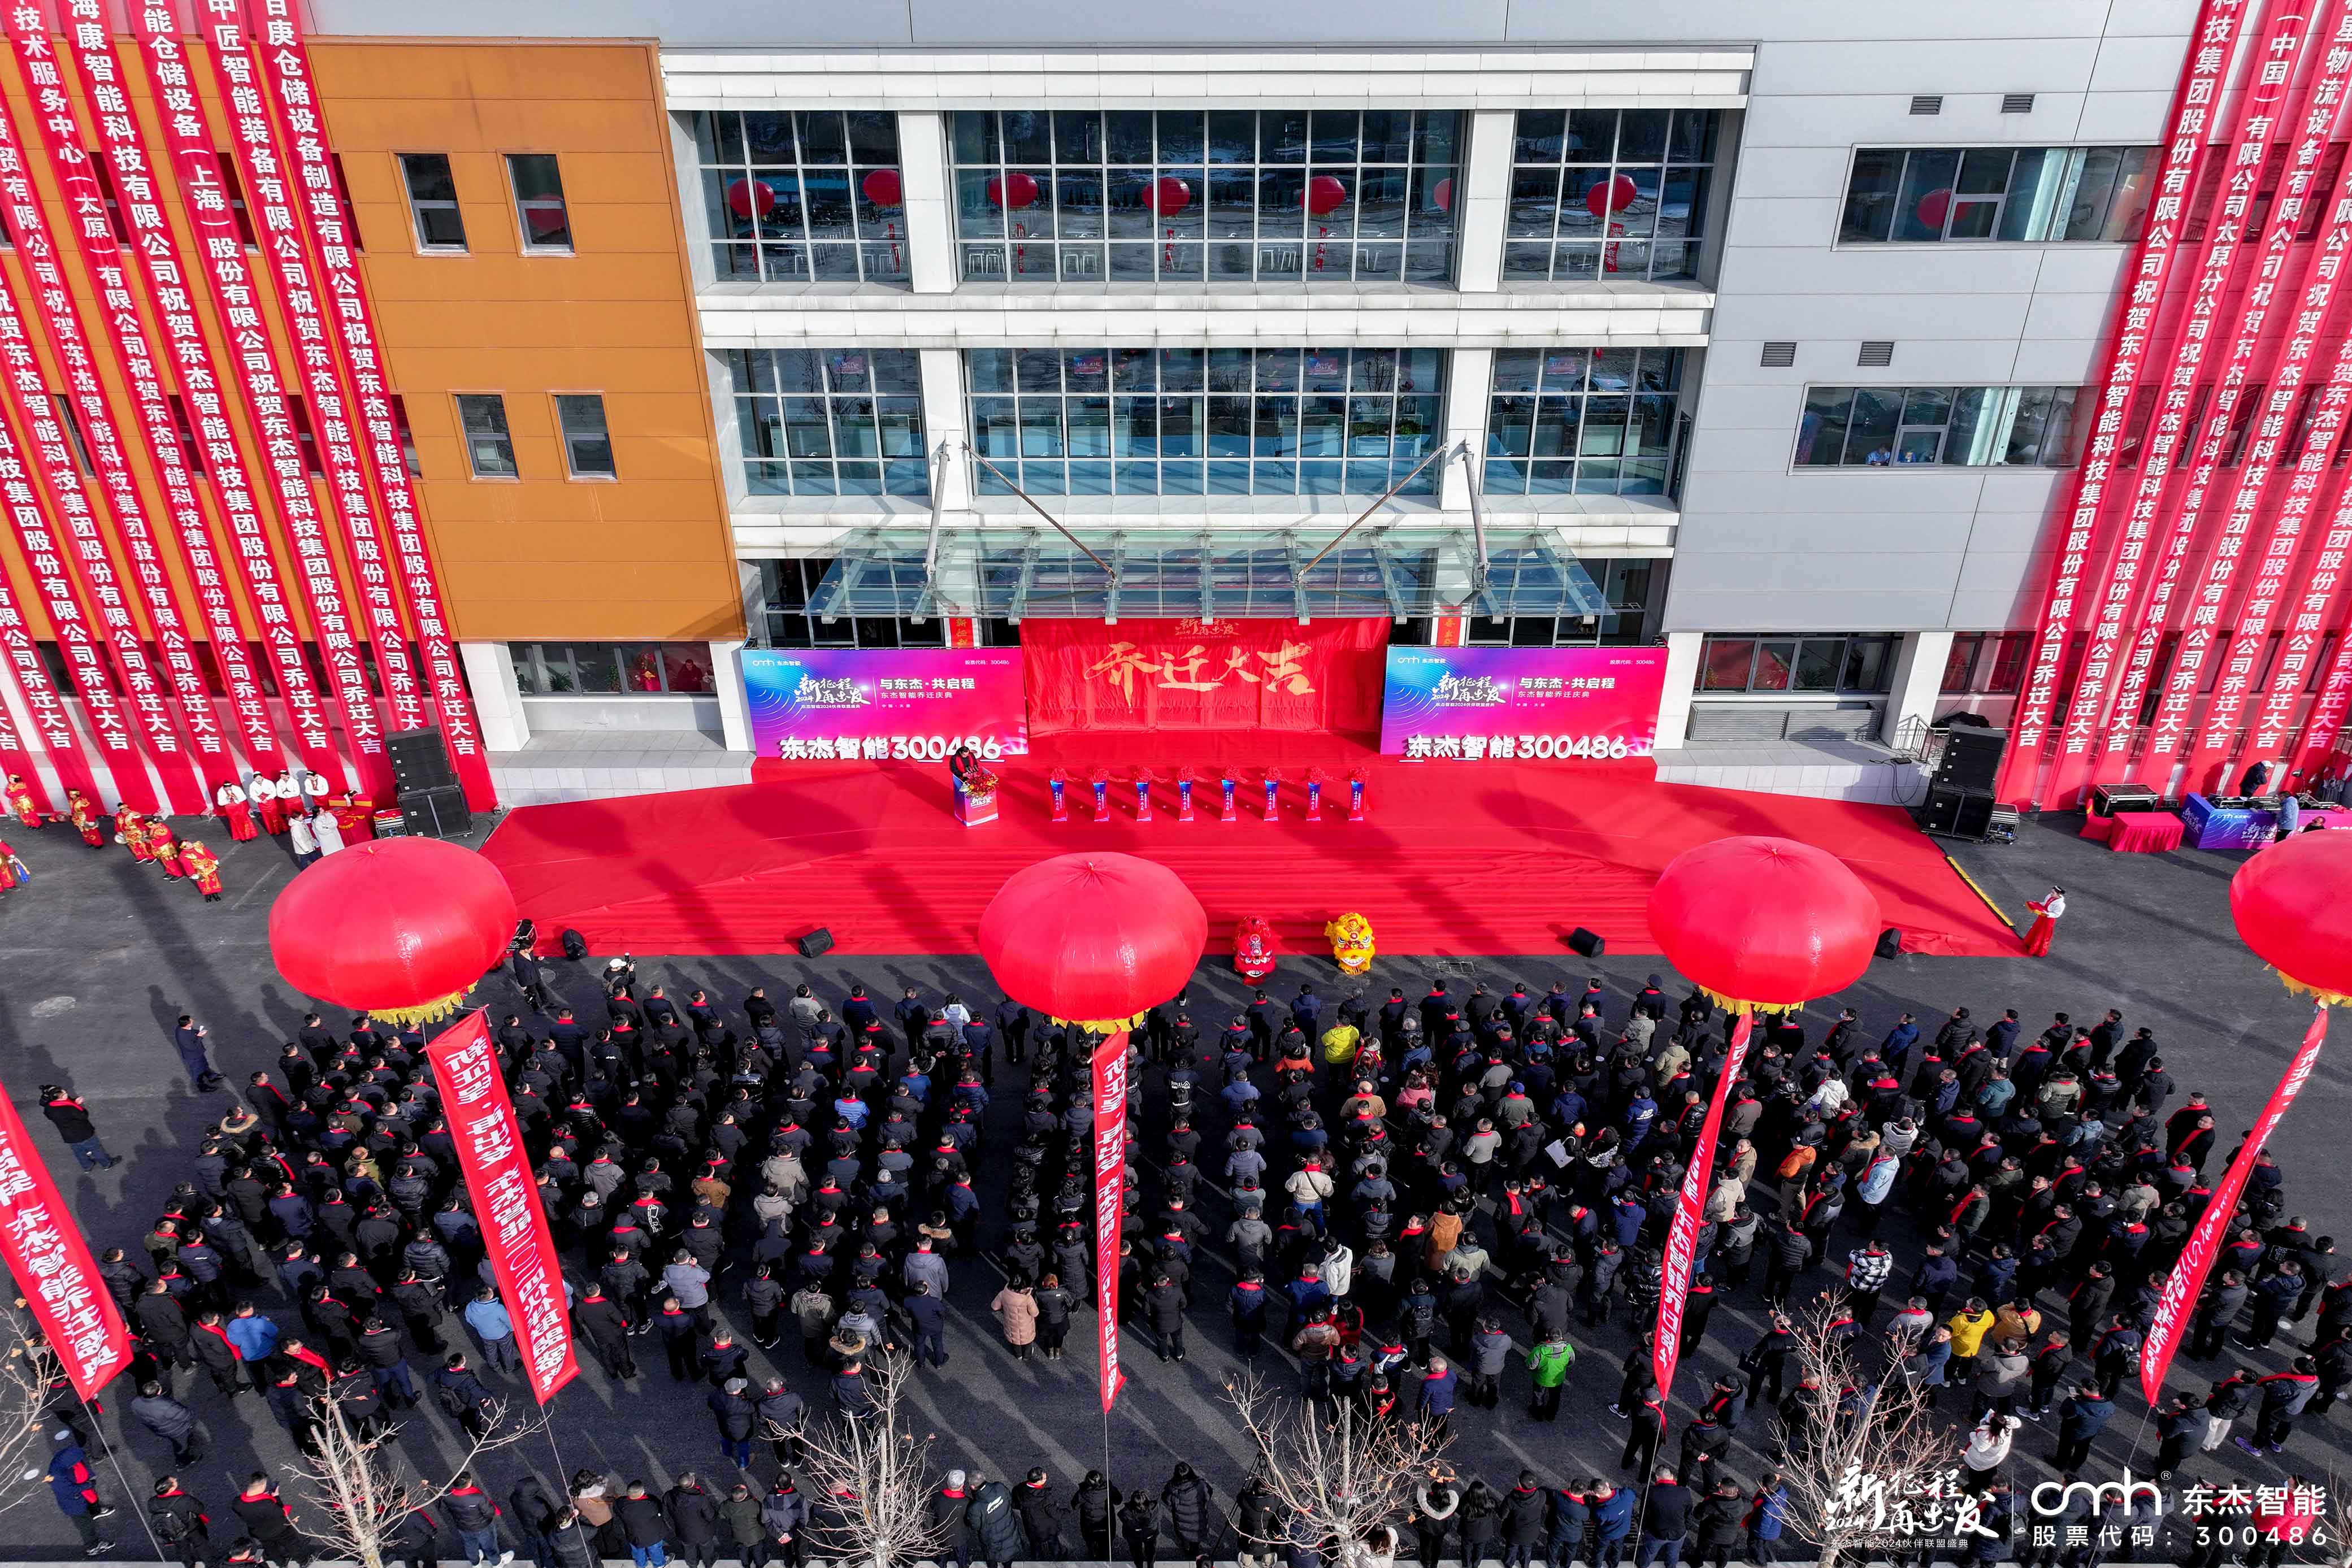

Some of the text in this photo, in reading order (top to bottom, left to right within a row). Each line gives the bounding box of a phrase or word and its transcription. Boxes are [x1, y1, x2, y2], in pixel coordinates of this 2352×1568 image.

[13, 0, 272, 752] 技术服务中心（太原）有限公司祝贺东杰智能科技集团股份有限公司乔迁大吉
[143, 0, 382, 755] 能仓储设备（上海）股份有限公司祝贺东杰智能科技集团股份有限公司乔迁大吉
[2154, 171, 2352, 753] 限公司祝贺东杰智能科技集团股份有限公司乔迁大吉
[880, 678, 975, 690] 与东杰·共启程
[1084, 640, 1316, 713] 乔迁大吉
[1519, 677, 1615, 689] 与东杰·共启程
